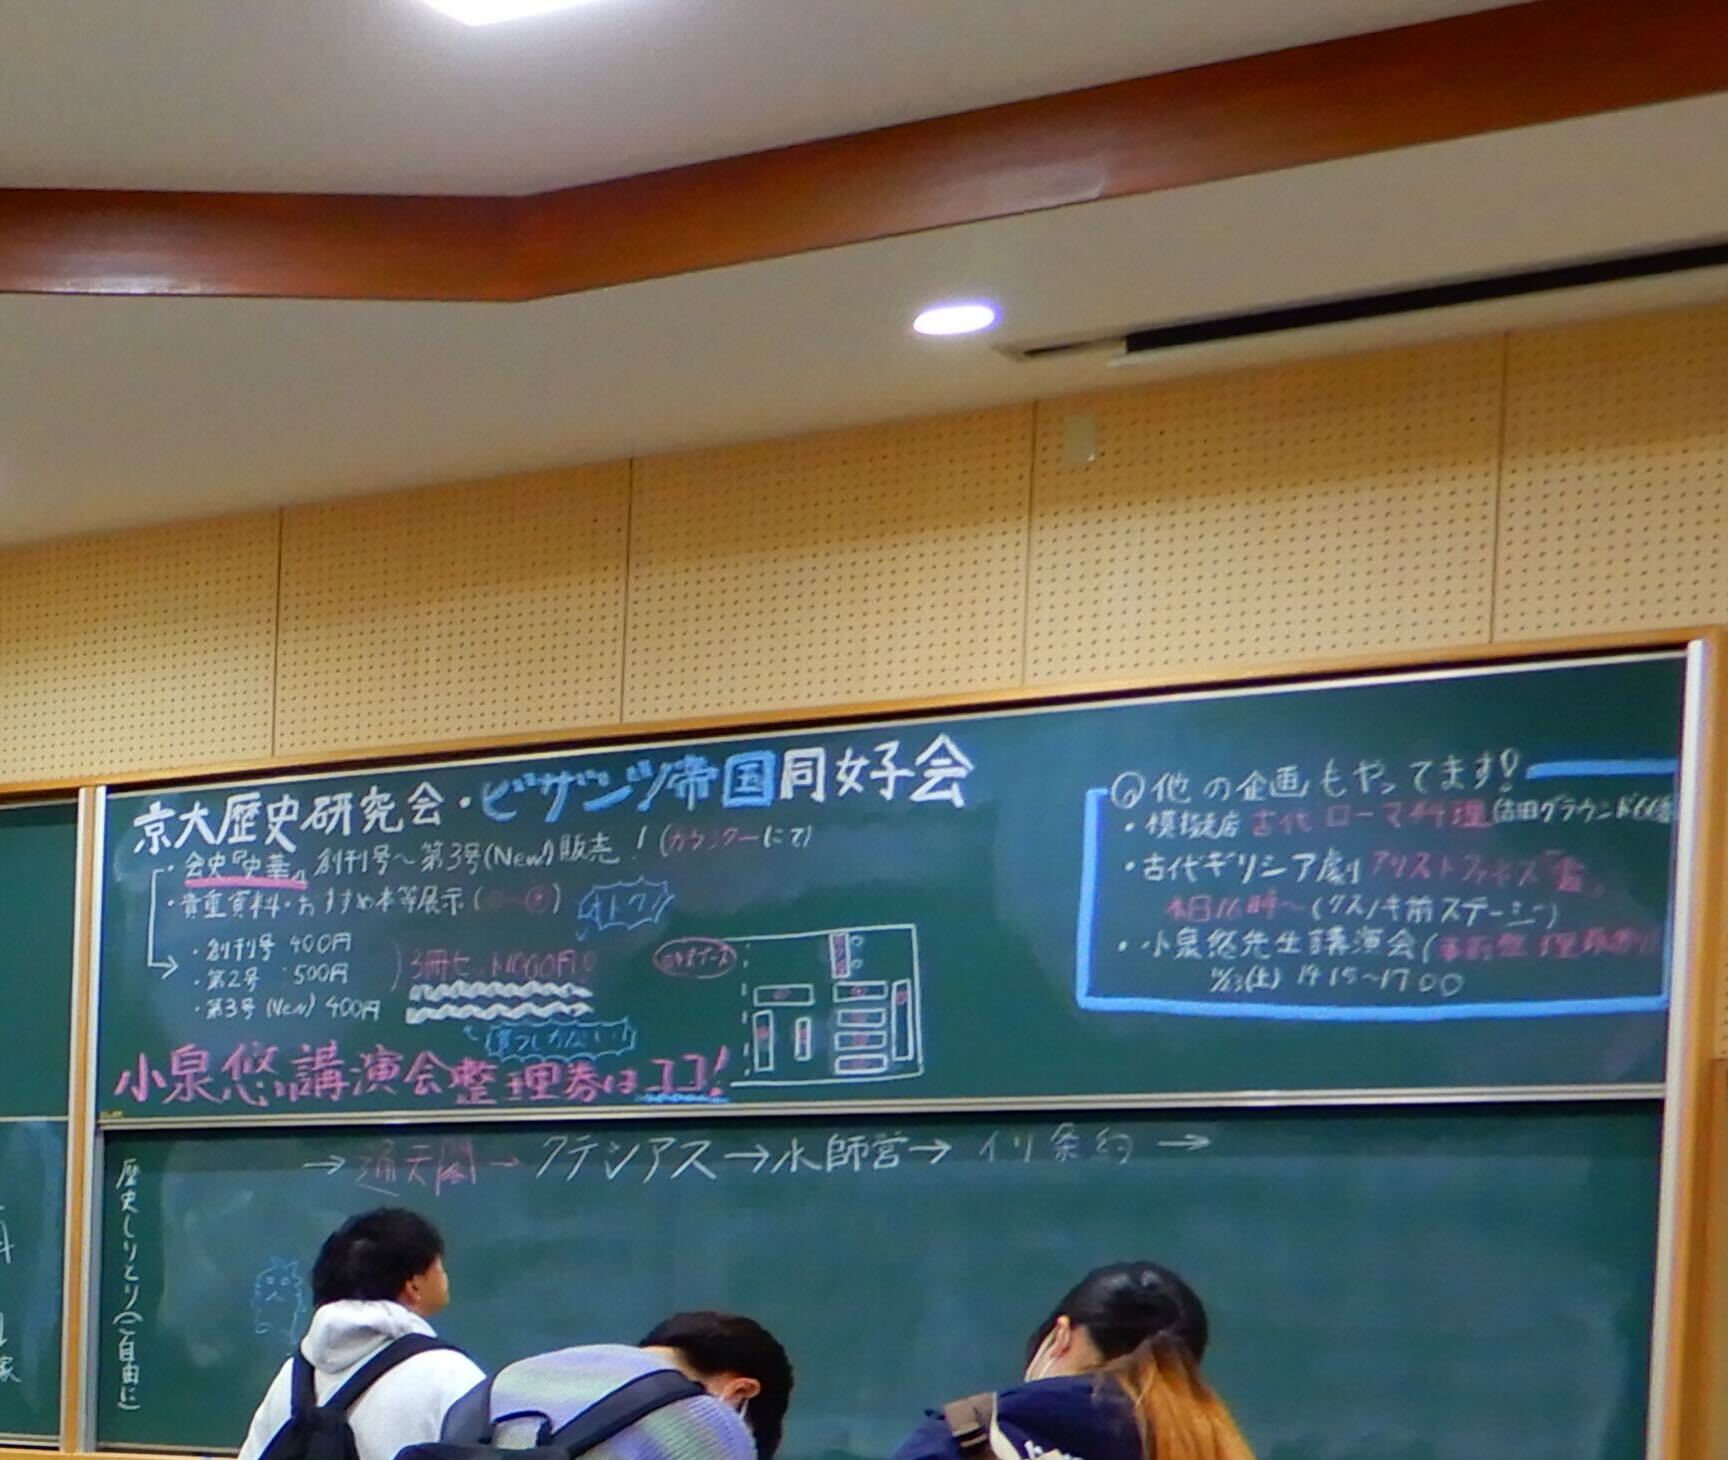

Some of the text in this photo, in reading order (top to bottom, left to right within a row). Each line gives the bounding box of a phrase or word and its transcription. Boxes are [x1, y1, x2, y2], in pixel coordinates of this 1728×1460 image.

[289, 931, 352, 954] 400円
[293, 963, 350, 985] 500円
[325, 997, 382, 1021] 400円
